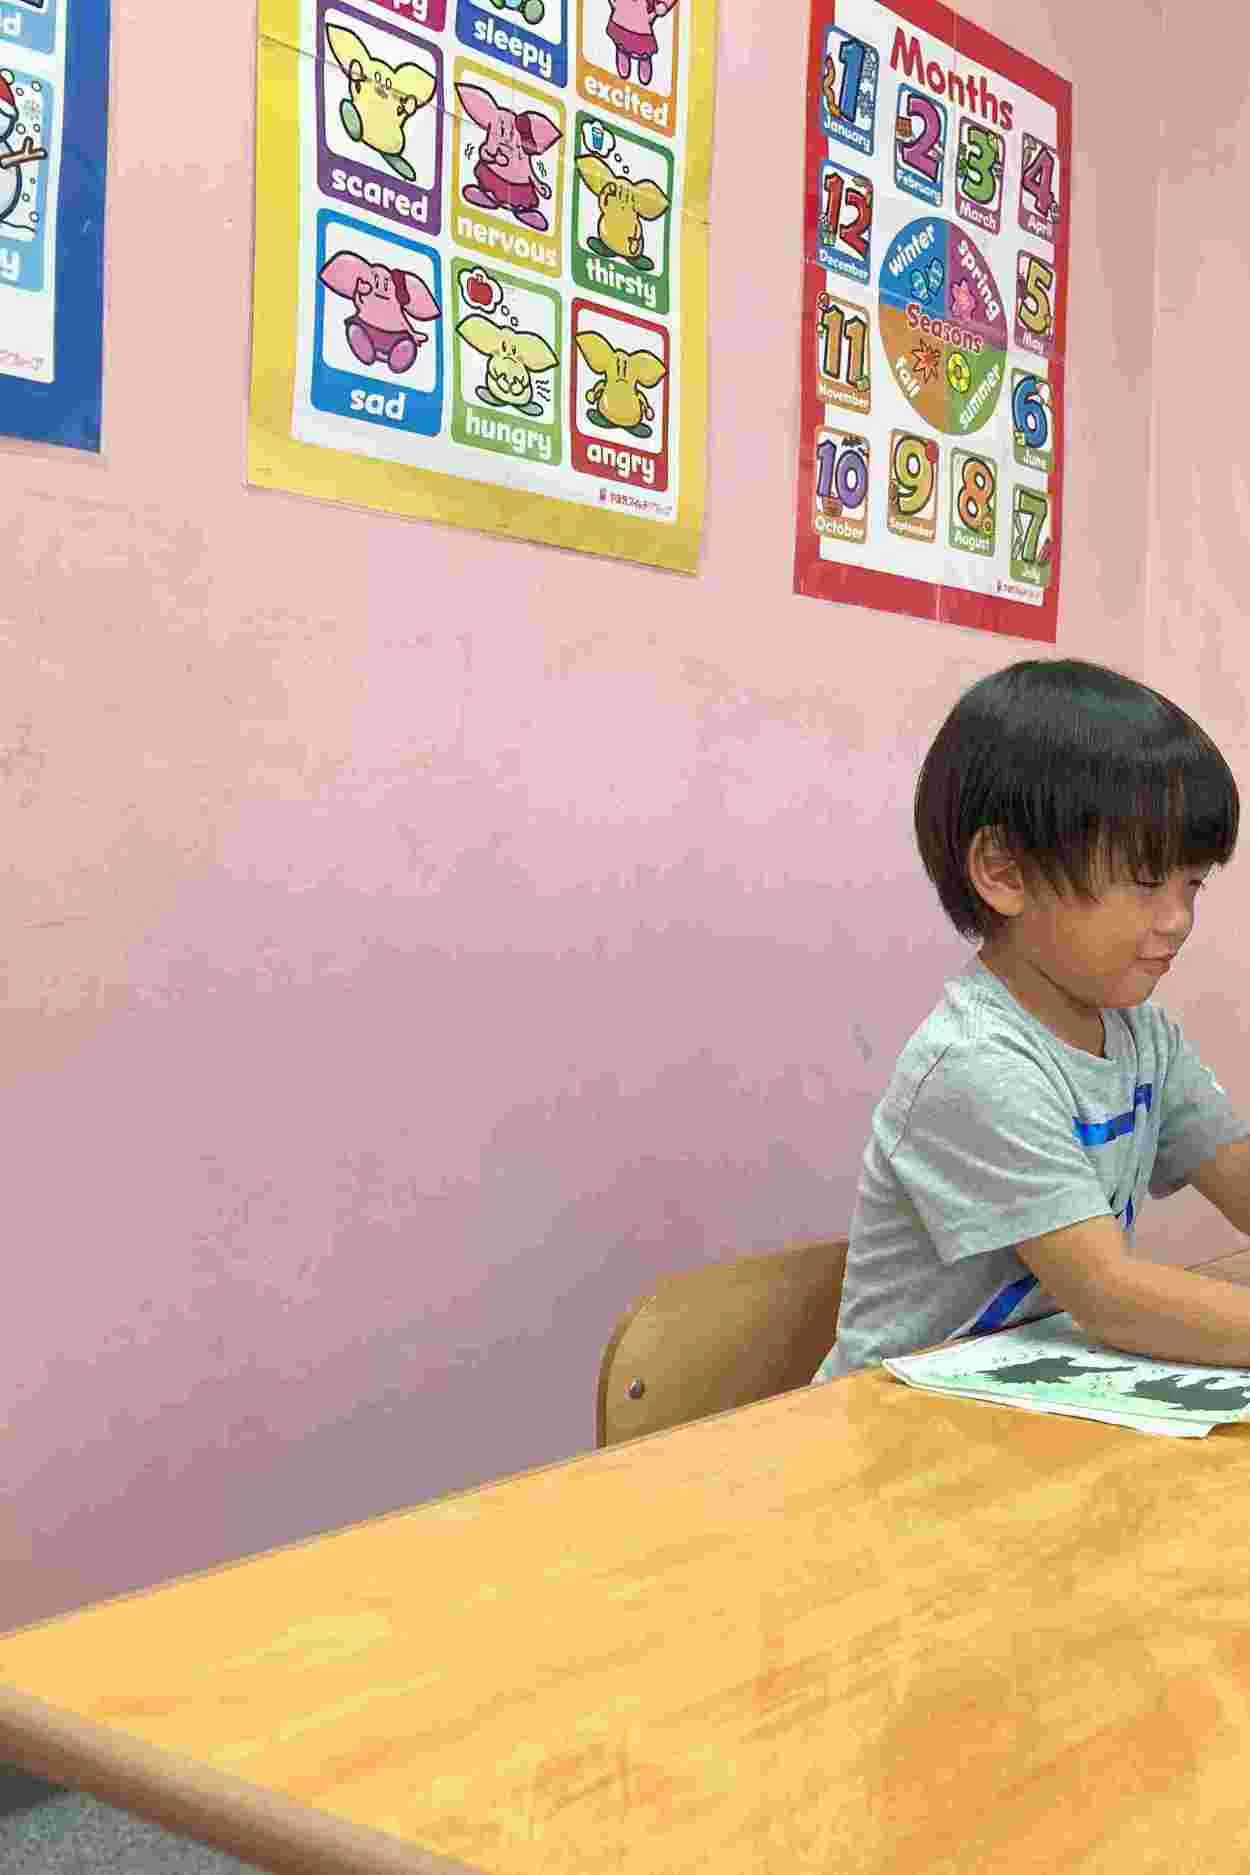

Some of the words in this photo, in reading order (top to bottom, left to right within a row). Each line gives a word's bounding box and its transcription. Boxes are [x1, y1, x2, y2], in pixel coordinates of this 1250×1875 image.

[472, 16, 552, 77] sleepy
[890, 27, 1013, 131] Months
[584, 75, 669, 127] excited
[839, 37, 866, 123] 1
[823, 117, 872, 153] January
[900, 93, 942, 184] 2
[961, 126, 997, 205] 3
[331, 168, 429, 223] scared
[1021, 146, 1055, 218] 4
[457, 217, 559, 268] nervous
[823, 172, 873, 259] 12
[960, 201, 998, 230] March
[585, 256, 657, 309] thirsty
[887, 223, 936, 276] winter
[957, 239, 1001, 321] spring
[904, 302, 984, 353] Seasons
[1018, 255, 1053, 335] 5
[821, 304, 869, 390] 11
[895, 354, 921, 399] fall
[349, 387, 406, 420] sad
[959, 365, 1002, 431] summer
[1012, 375, 1048, 449] 6
[465, 412, 552, 460] hungry
[587, 442, 655, 484] angry
[816, 438, 869, 509] 10
[894, 435, 935, 516] 9
[957, 456, 995, 532] 8
[815, 514, 865, 540] October
[1018, 489, 1048, 563] 7
